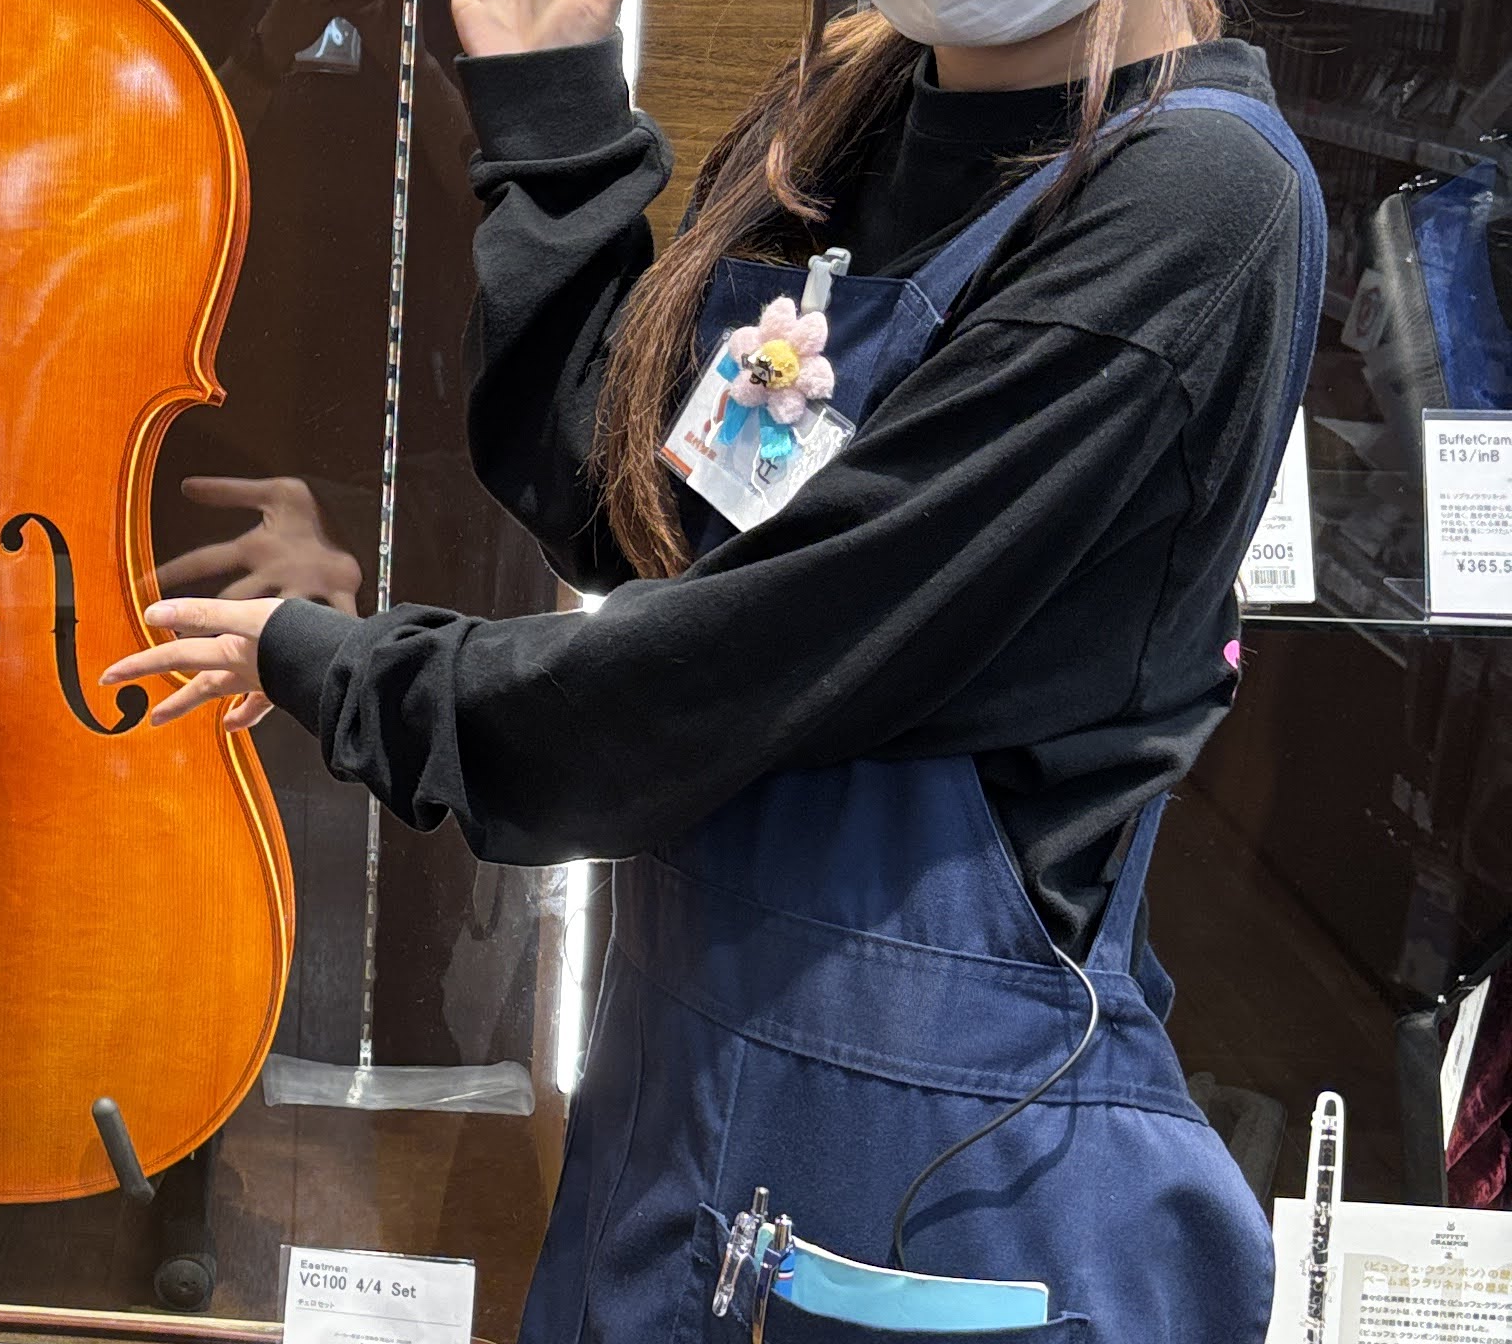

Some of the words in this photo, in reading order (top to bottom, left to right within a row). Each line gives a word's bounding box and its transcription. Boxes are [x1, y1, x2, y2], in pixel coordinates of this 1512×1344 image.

[1439, 450, 1500, 462] E13/inB
[300, 1260, 348, 1274] Eastman
[299, 1272, 347, 1291] VC100
[356, 1278, 382, 1295] 4/4
[391, 1283, 417, 1299] Set
